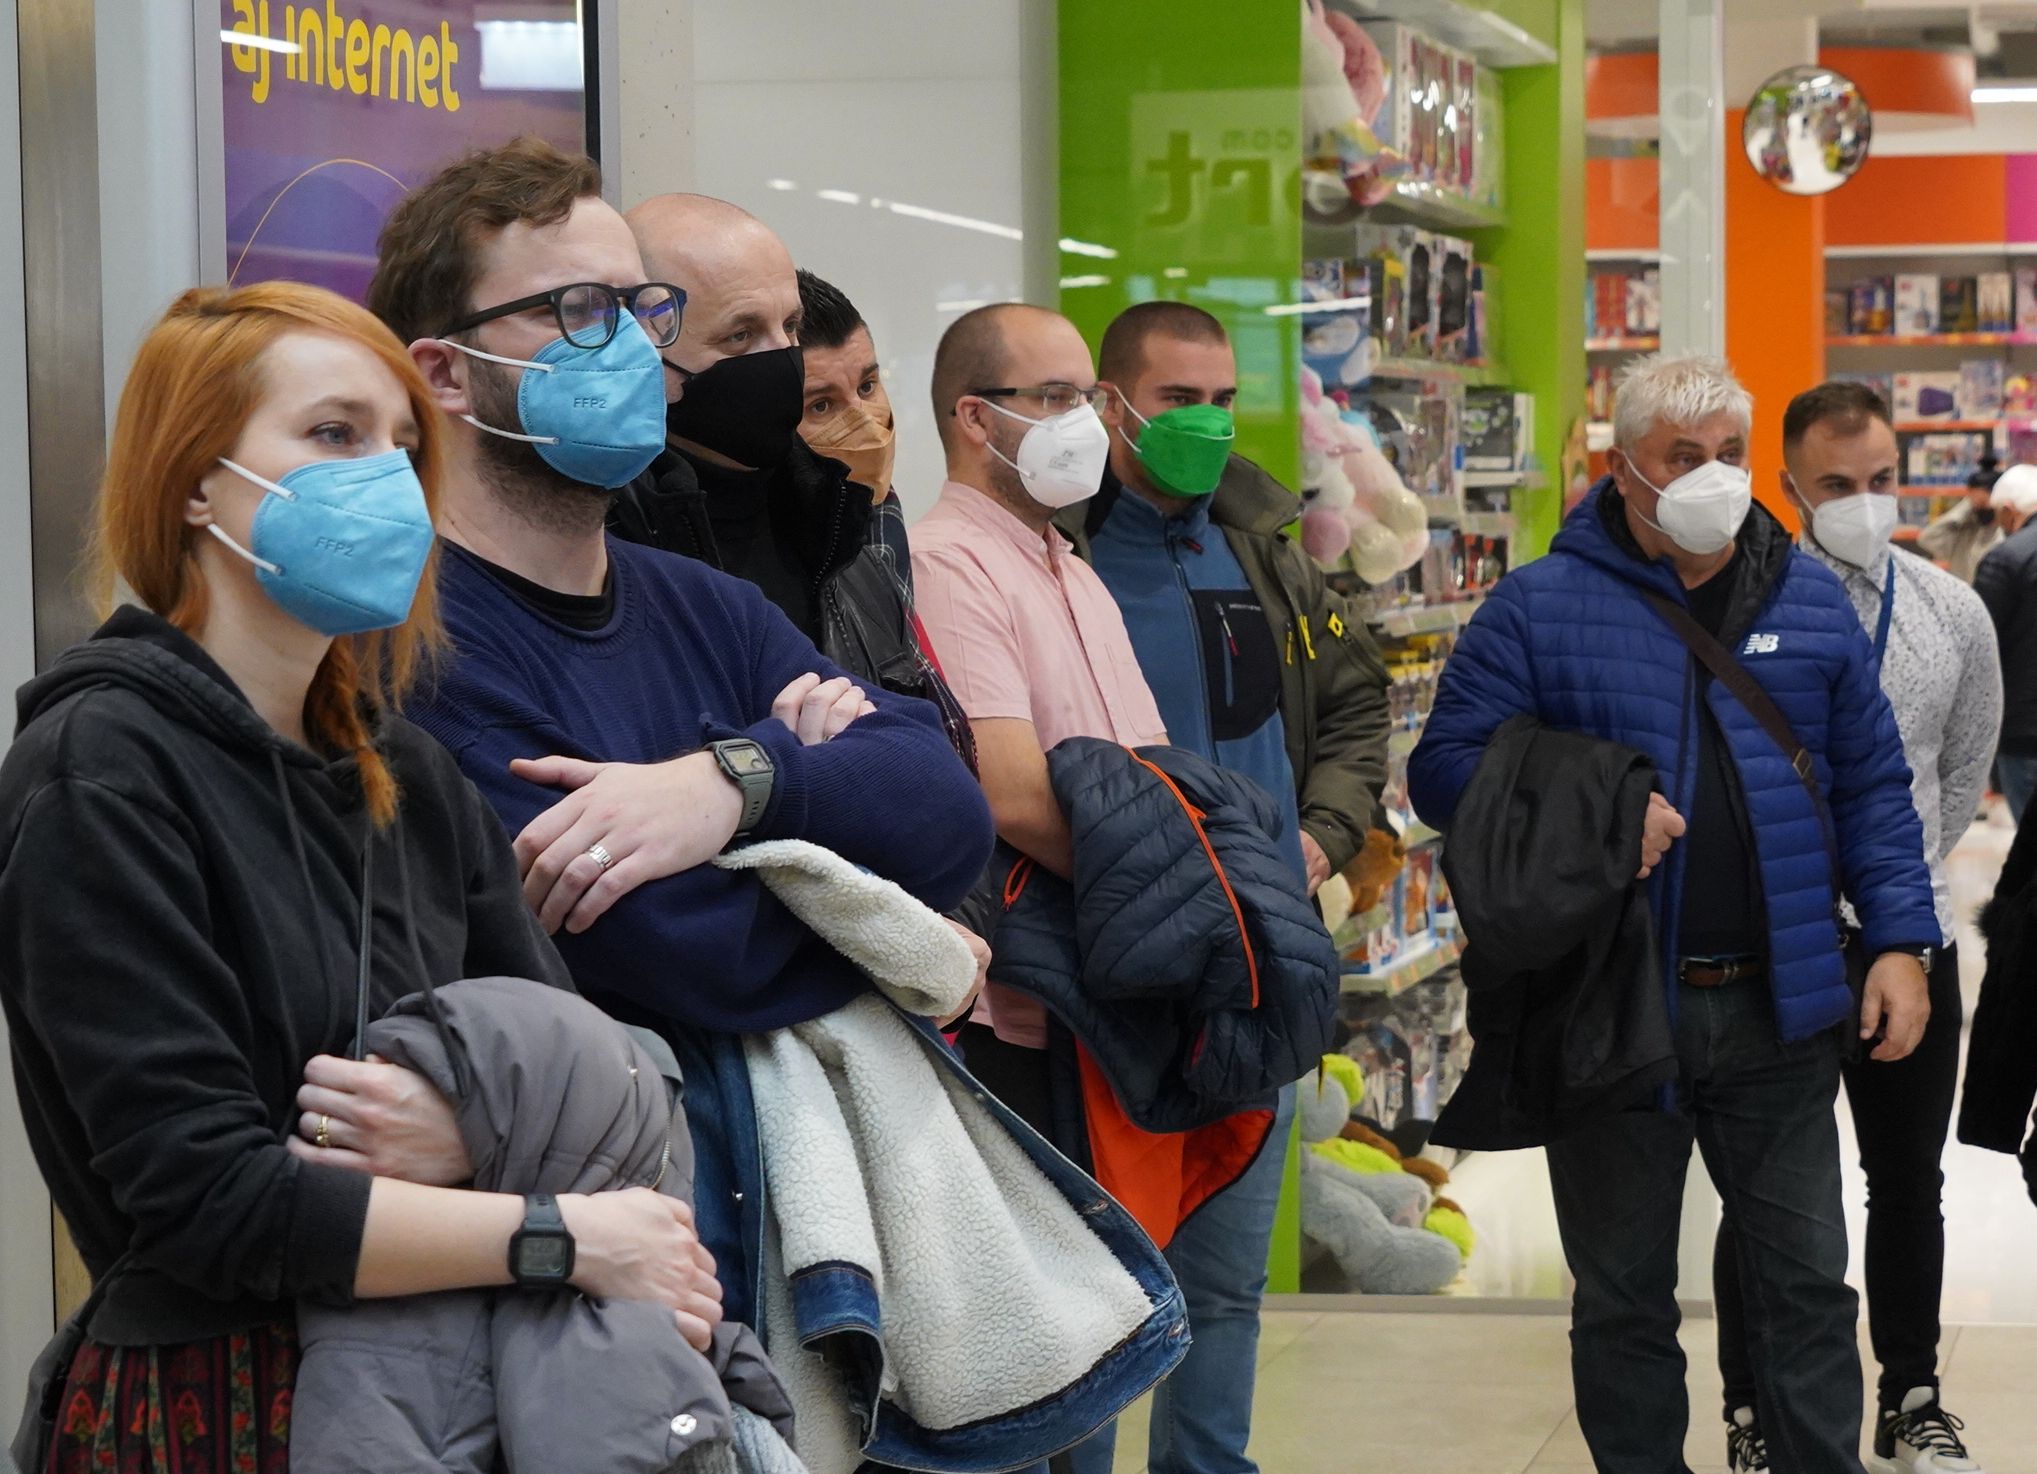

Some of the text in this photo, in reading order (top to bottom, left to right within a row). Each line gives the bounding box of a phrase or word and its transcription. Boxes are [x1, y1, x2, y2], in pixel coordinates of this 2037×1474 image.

[232, 0, 460, 112] aj internet
[573, 397, 608, 409] FFP2
[313, 535, 354, 558] FFP2
[1743, 633, 1779, 655] NB
